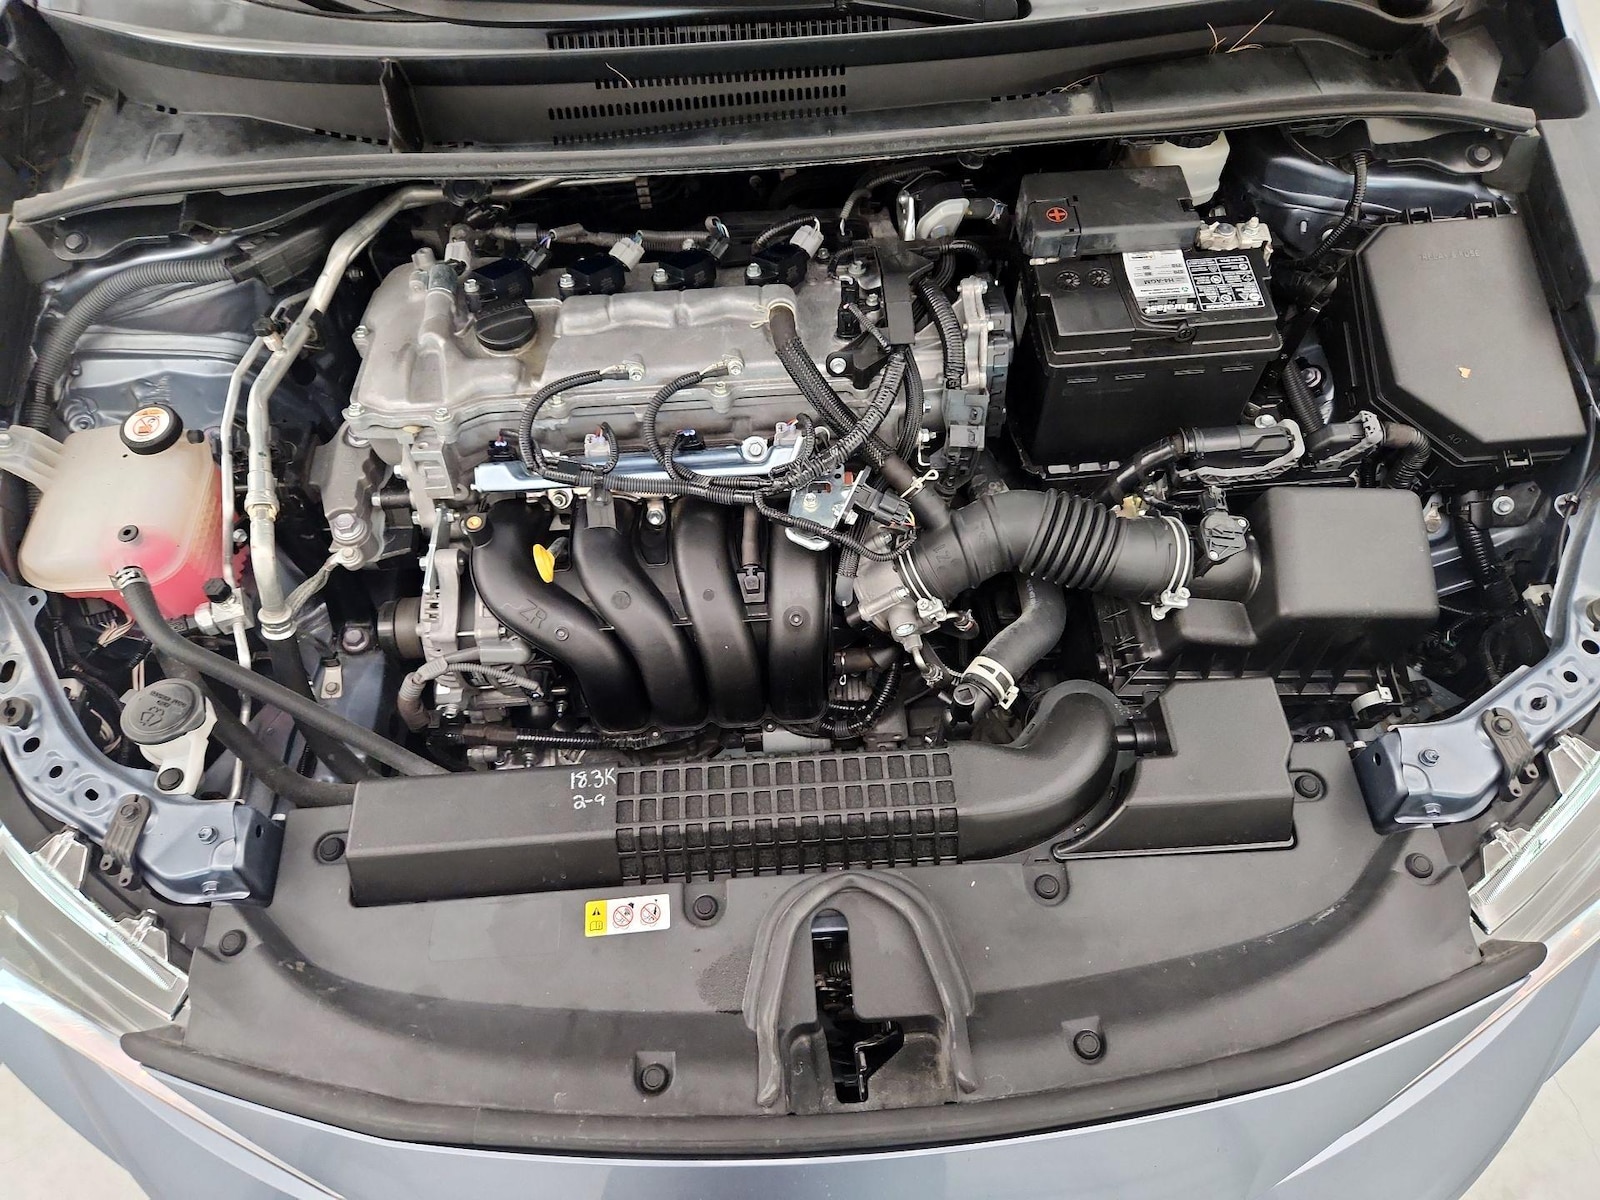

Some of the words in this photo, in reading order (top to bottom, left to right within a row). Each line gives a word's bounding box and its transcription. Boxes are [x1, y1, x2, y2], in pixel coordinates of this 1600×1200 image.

[1144, 302, 1196, 314] Duralast
[519, 598, 548, 629] ZR
[570, 767, 617, 790] 18.3K
[572, 793, 606, 810] 2-9
